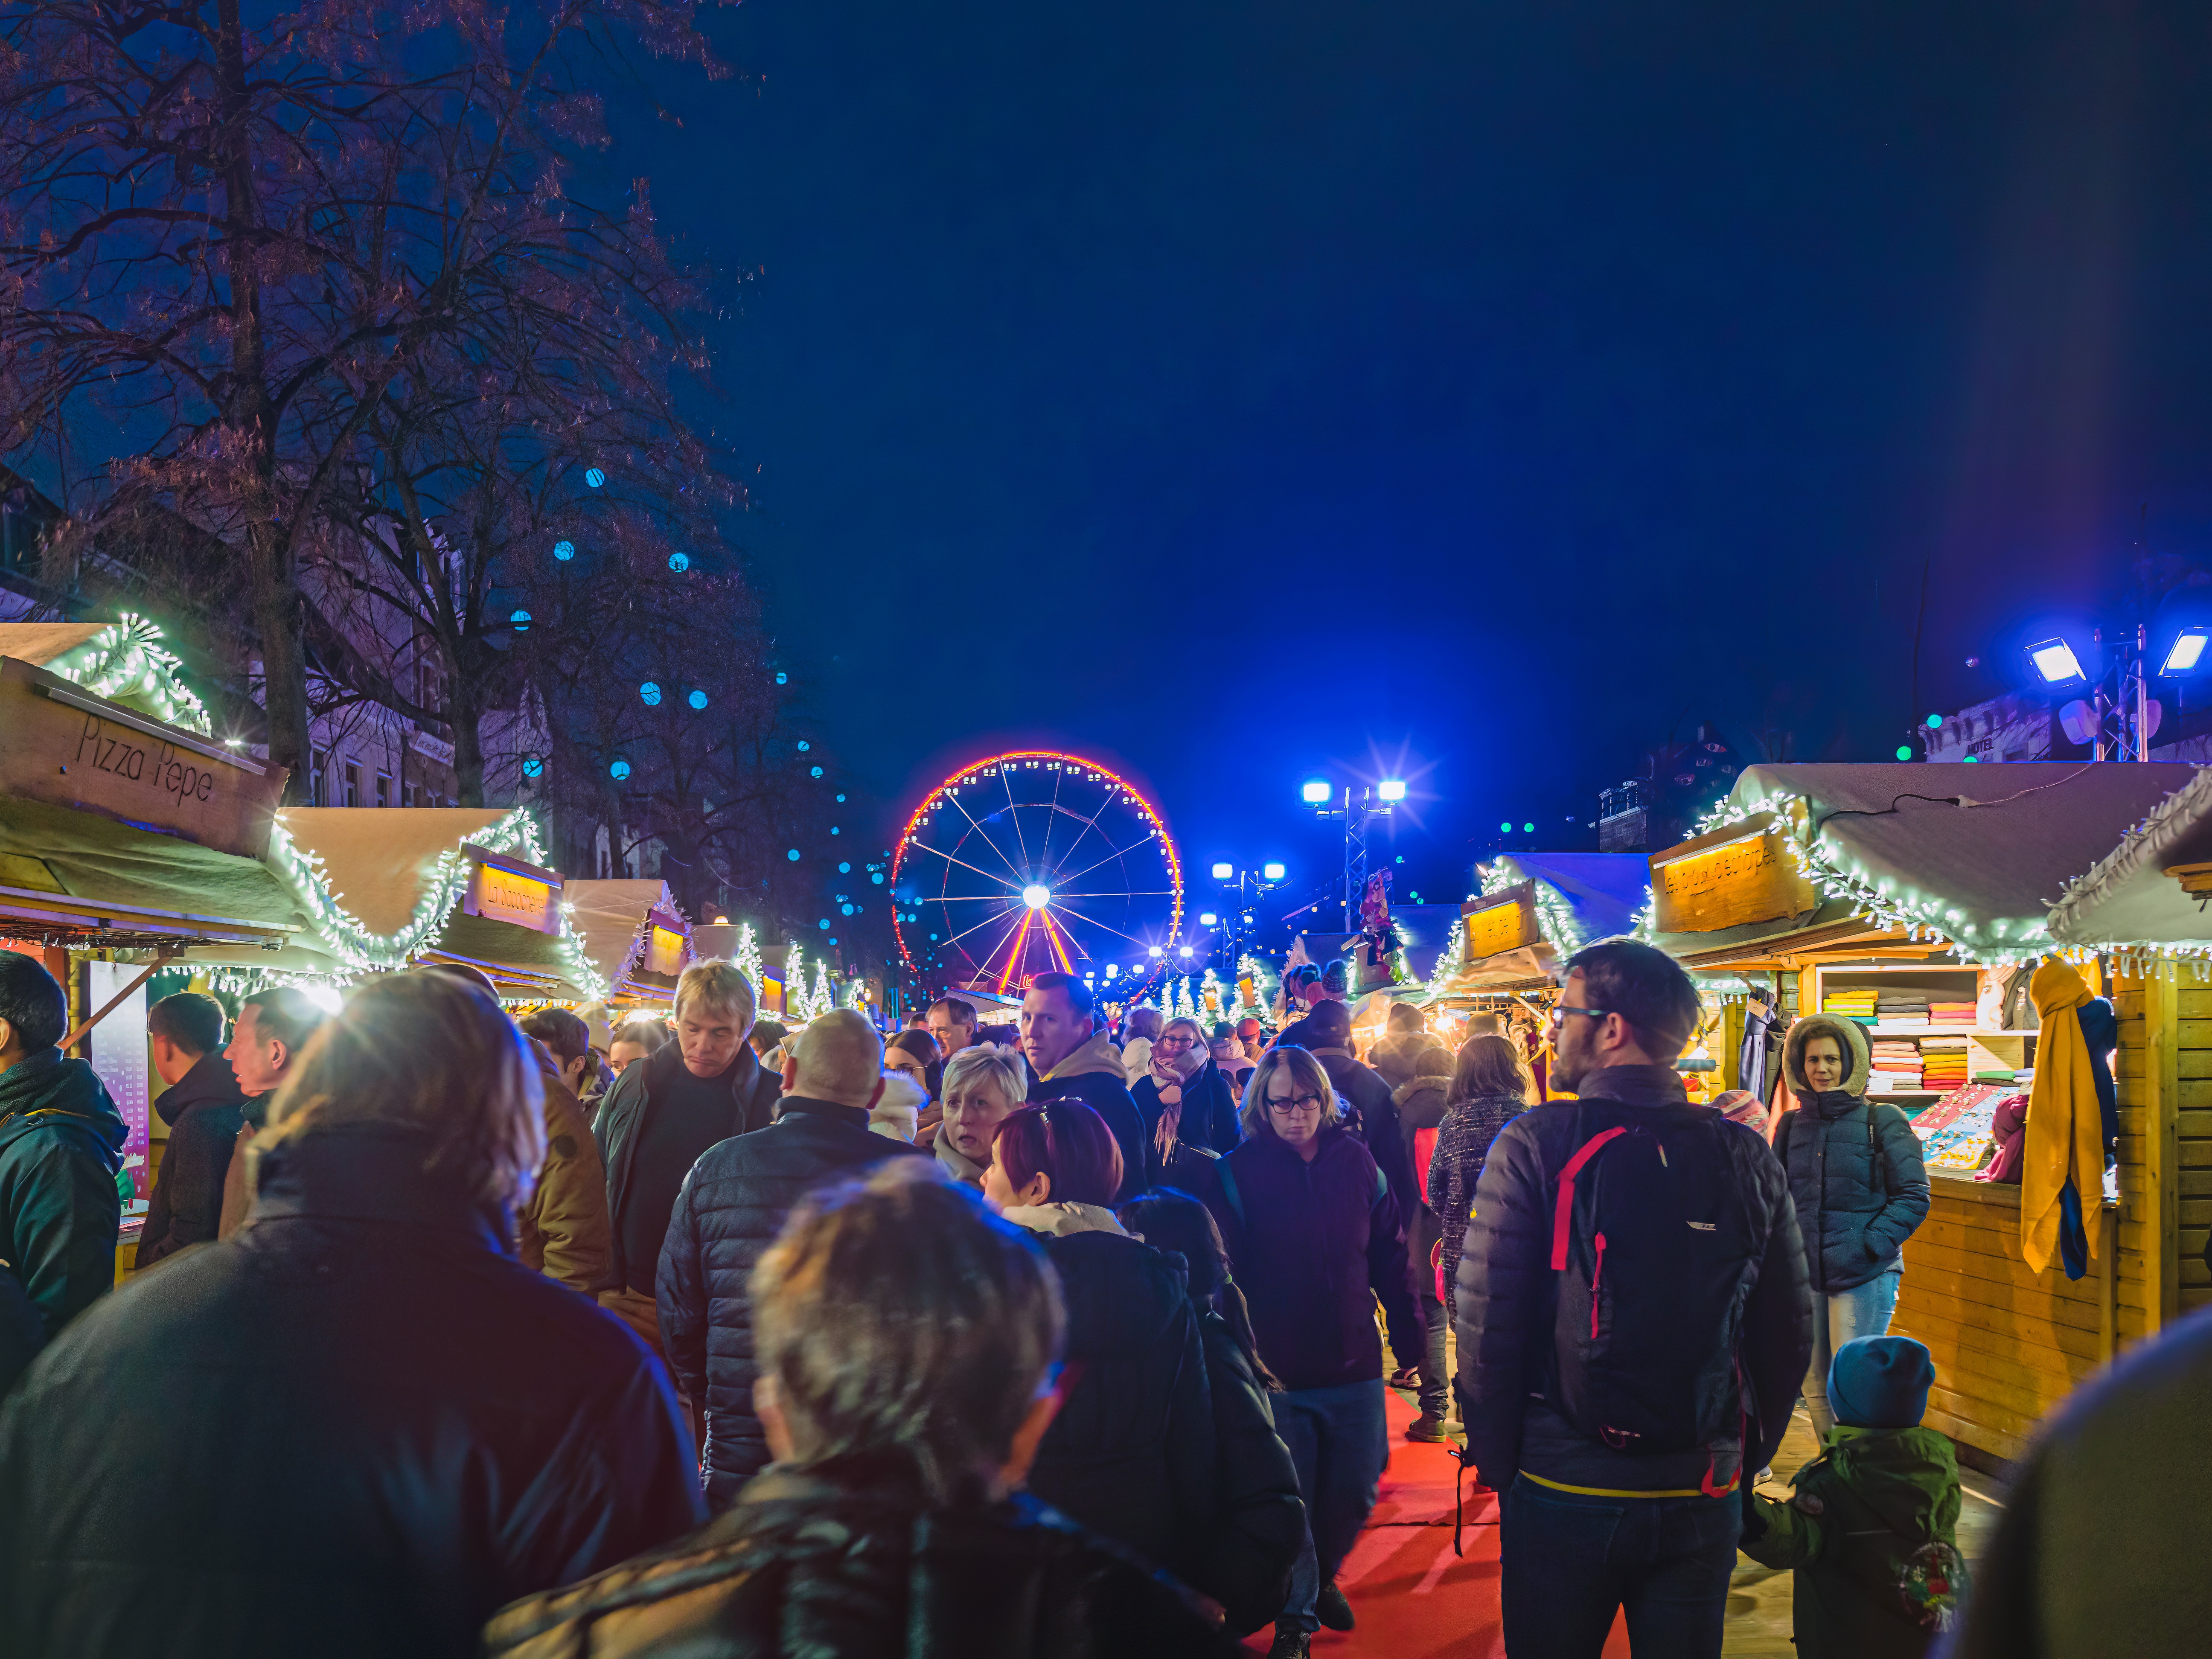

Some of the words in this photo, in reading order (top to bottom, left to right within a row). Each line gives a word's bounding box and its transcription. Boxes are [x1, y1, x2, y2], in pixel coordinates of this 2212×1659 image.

[76, 715, 145, 780] Pizza
[154, 742, 212, 808] Pepe
[1968, 738, 1994, 754] HOTEL
